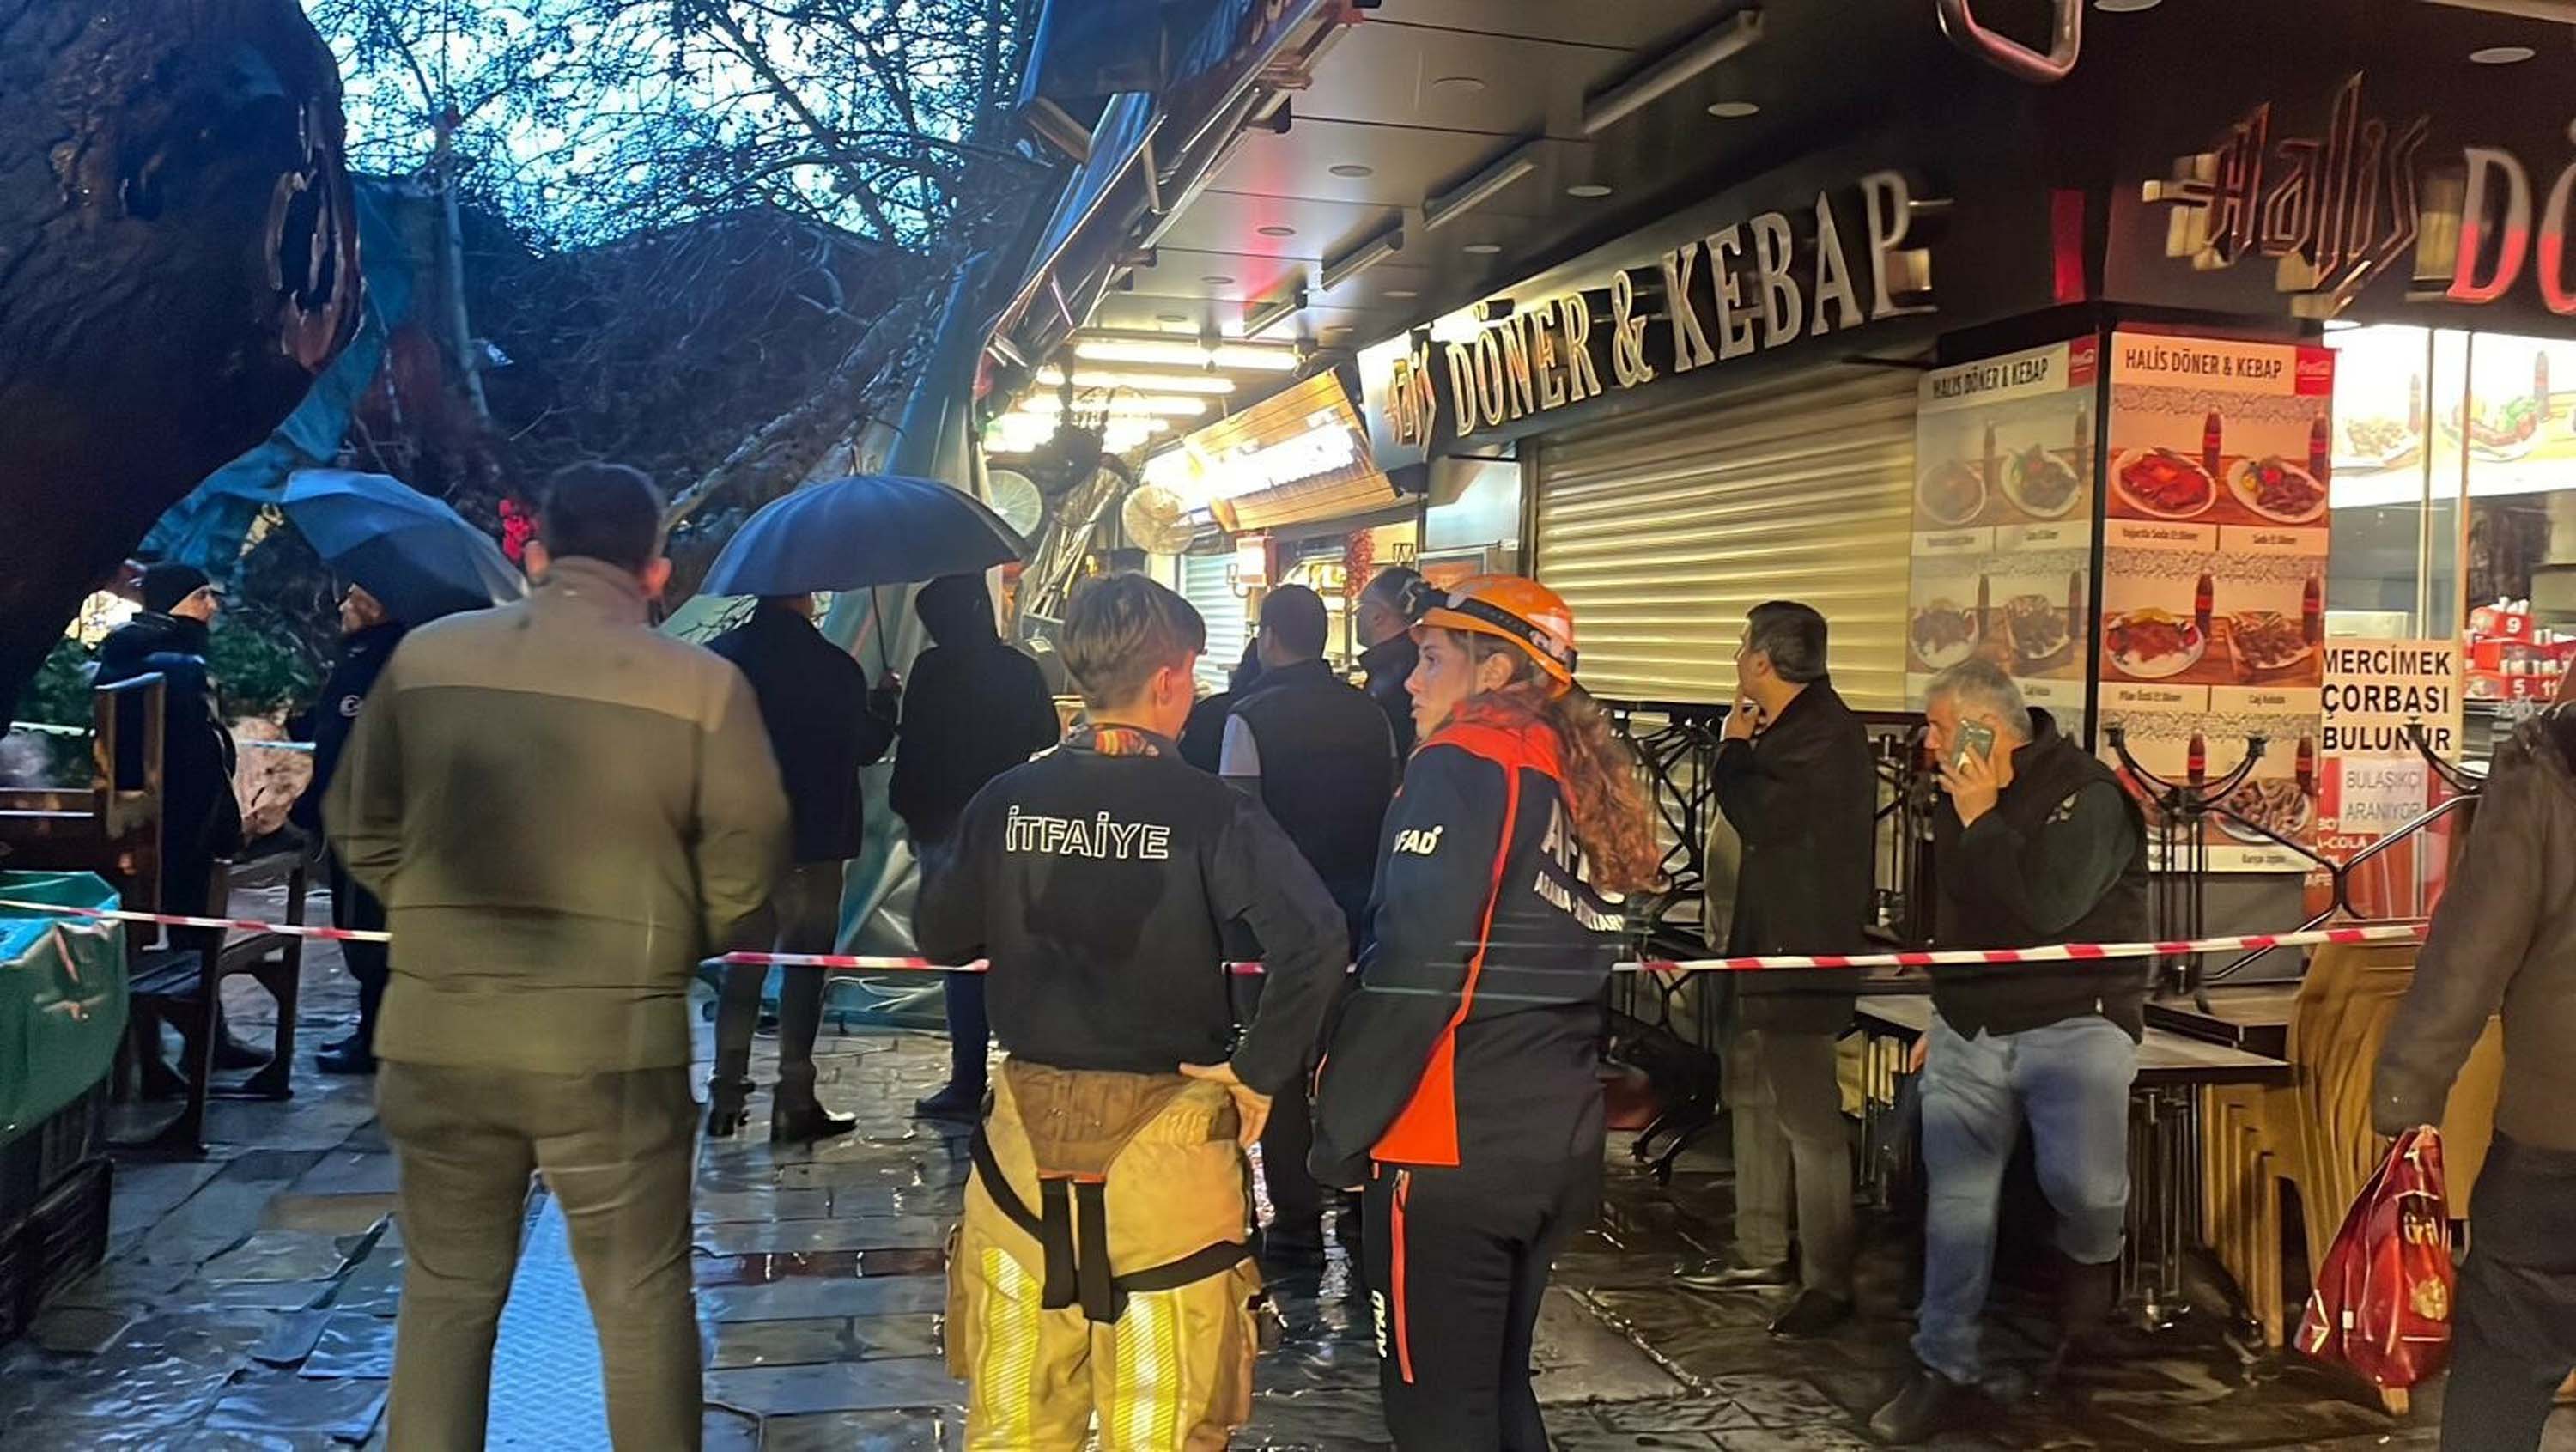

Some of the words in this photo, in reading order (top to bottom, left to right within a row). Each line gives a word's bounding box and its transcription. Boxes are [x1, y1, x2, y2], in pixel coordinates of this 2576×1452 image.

[1445, 291, 1602, 438] DÖNER
[1610, 269, 1655, 388] &
[1662, 170, 1912, 374] KEBAP
[2125, 345, 2168, 371] HALİS
[2172, 349, 2219, 374] DÖNER
[2222, 356, 2233, 376] &
[2236, 356, 2282, 378] KEBAP
[2506, 617, 2522, 634] 9
[2323, 644, 2451, 675] MERCİMEK
[2322, 683, 2449, 720] ÇORBASI
[2512, 678, 2525, 695] 5
[1005, 805, 1170, 859] İTFAİYE
